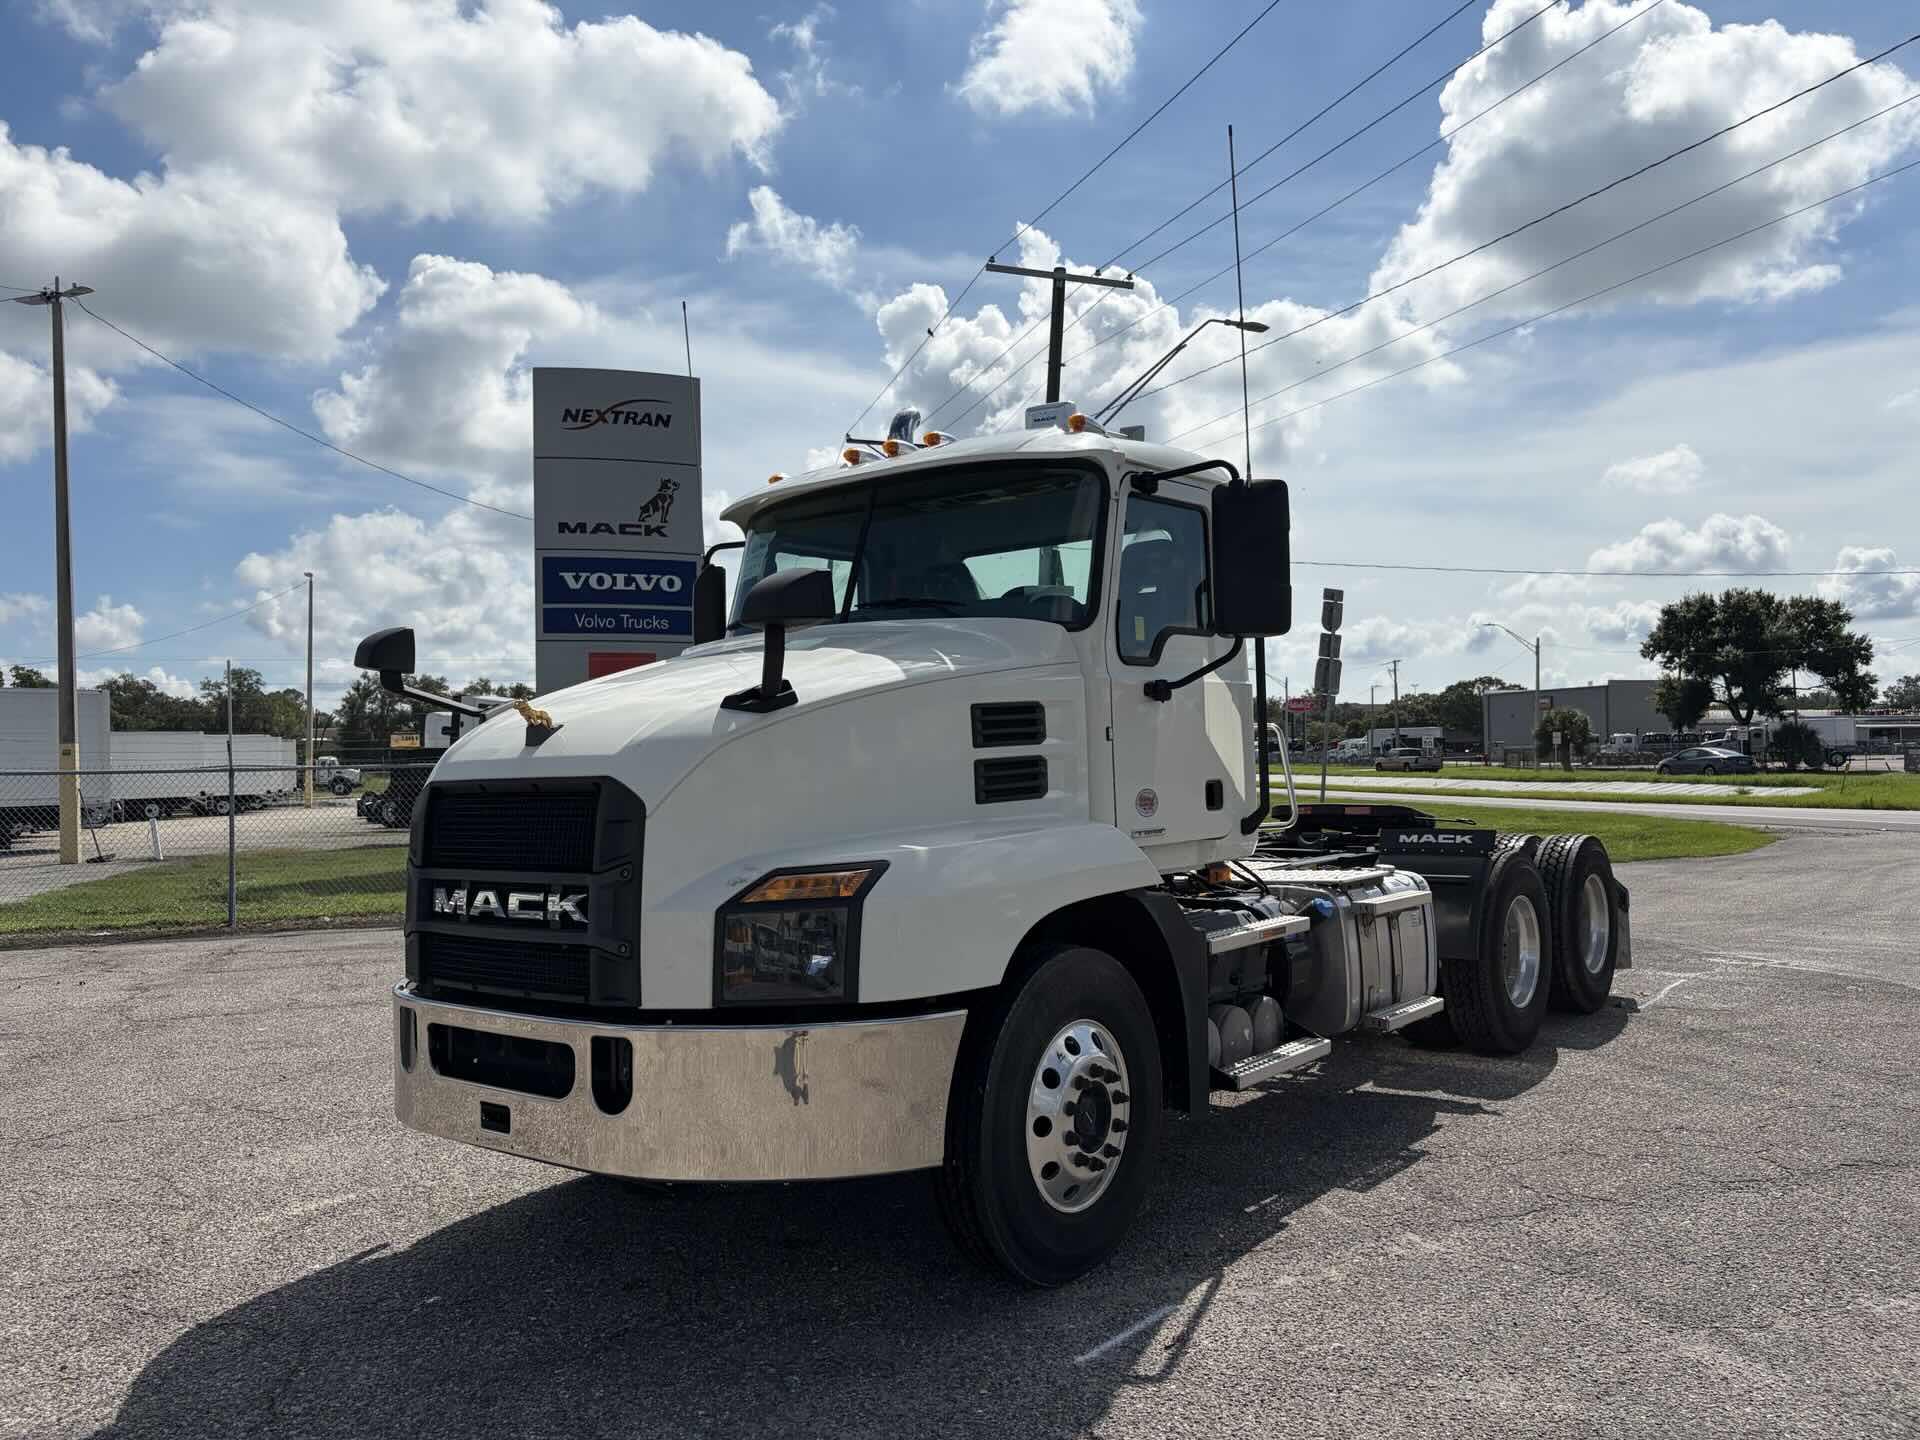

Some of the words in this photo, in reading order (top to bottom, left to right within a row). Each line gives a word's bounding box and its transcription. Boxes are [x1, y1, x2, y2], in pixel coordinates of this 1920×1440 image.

[561, 408, 672, 428] NEXTRAN
[558, 522, 669, 537] MACK
[559, 572, 682, 592] VOLVO
[574, 613, 616, 629] Volvo
[620, 614, 670, 630] Trucks
[1399, 833, 1473, 844] MACK
[433, 887, 590, 924] MACK
